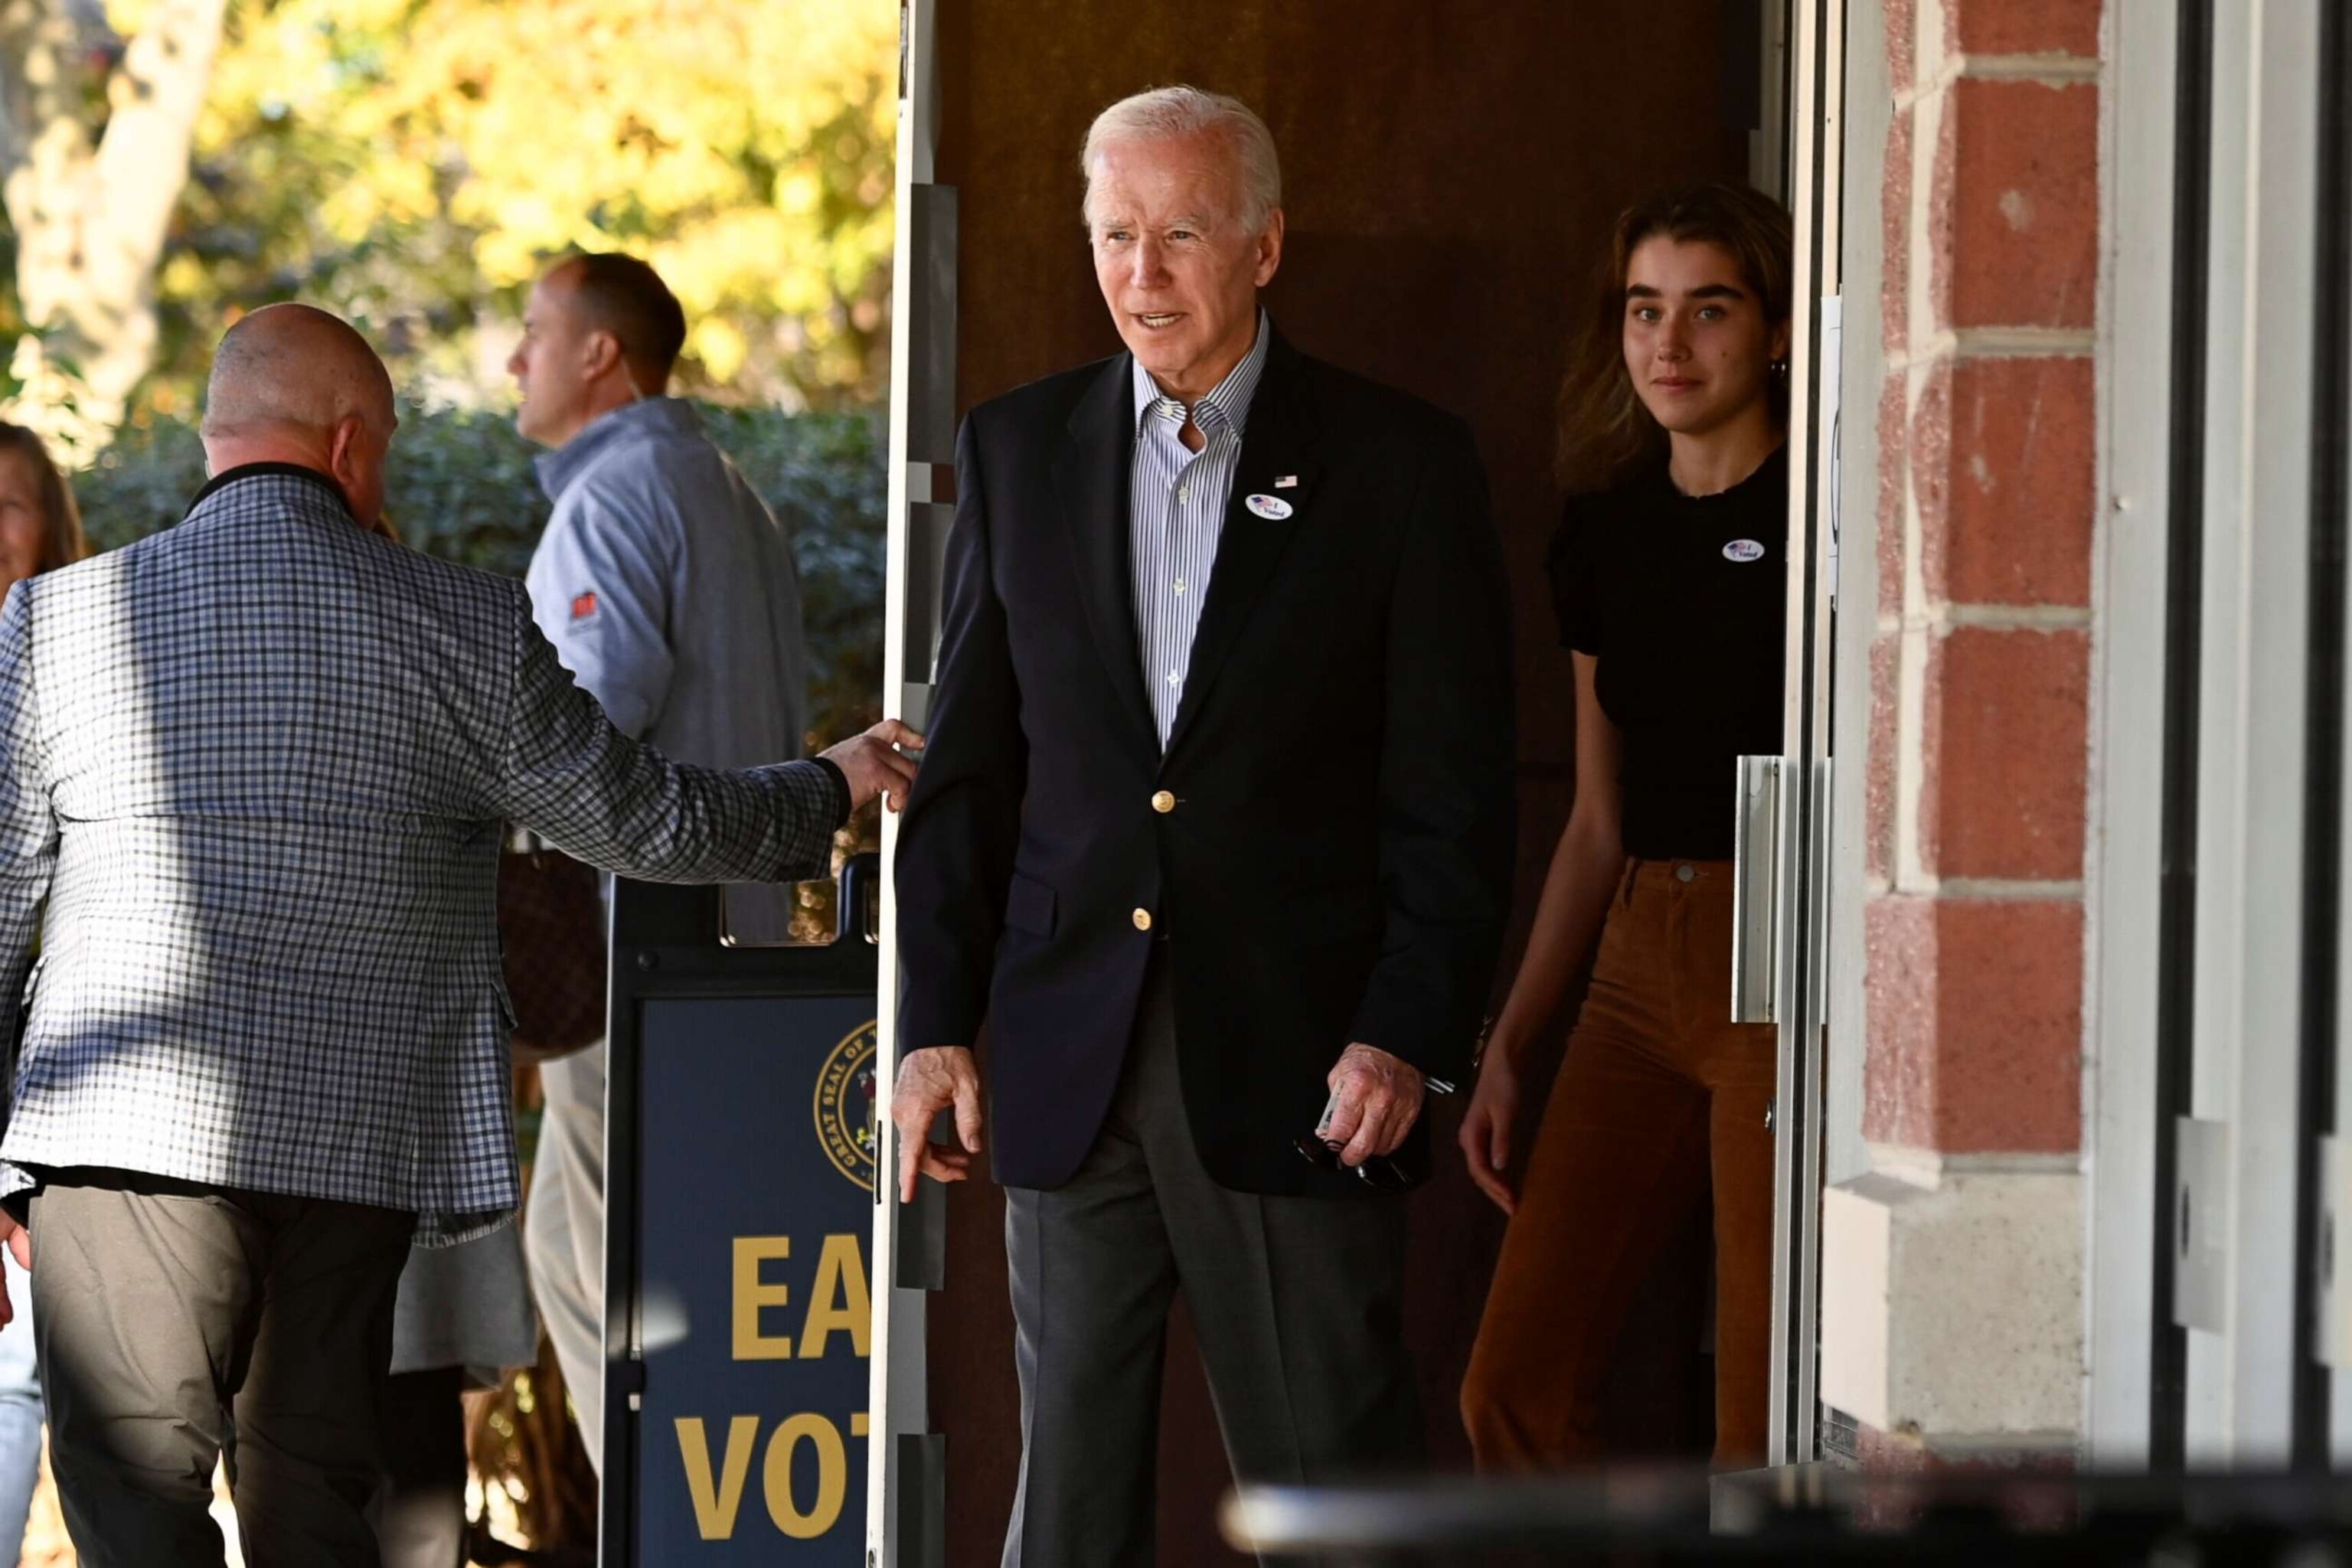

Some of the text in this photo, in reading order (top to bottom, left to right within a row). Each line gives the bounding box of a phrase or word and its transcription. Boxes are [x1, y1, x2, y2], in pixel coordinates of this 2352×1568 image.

[823, 1038, 864, 1167] GREAT SEAL OF
